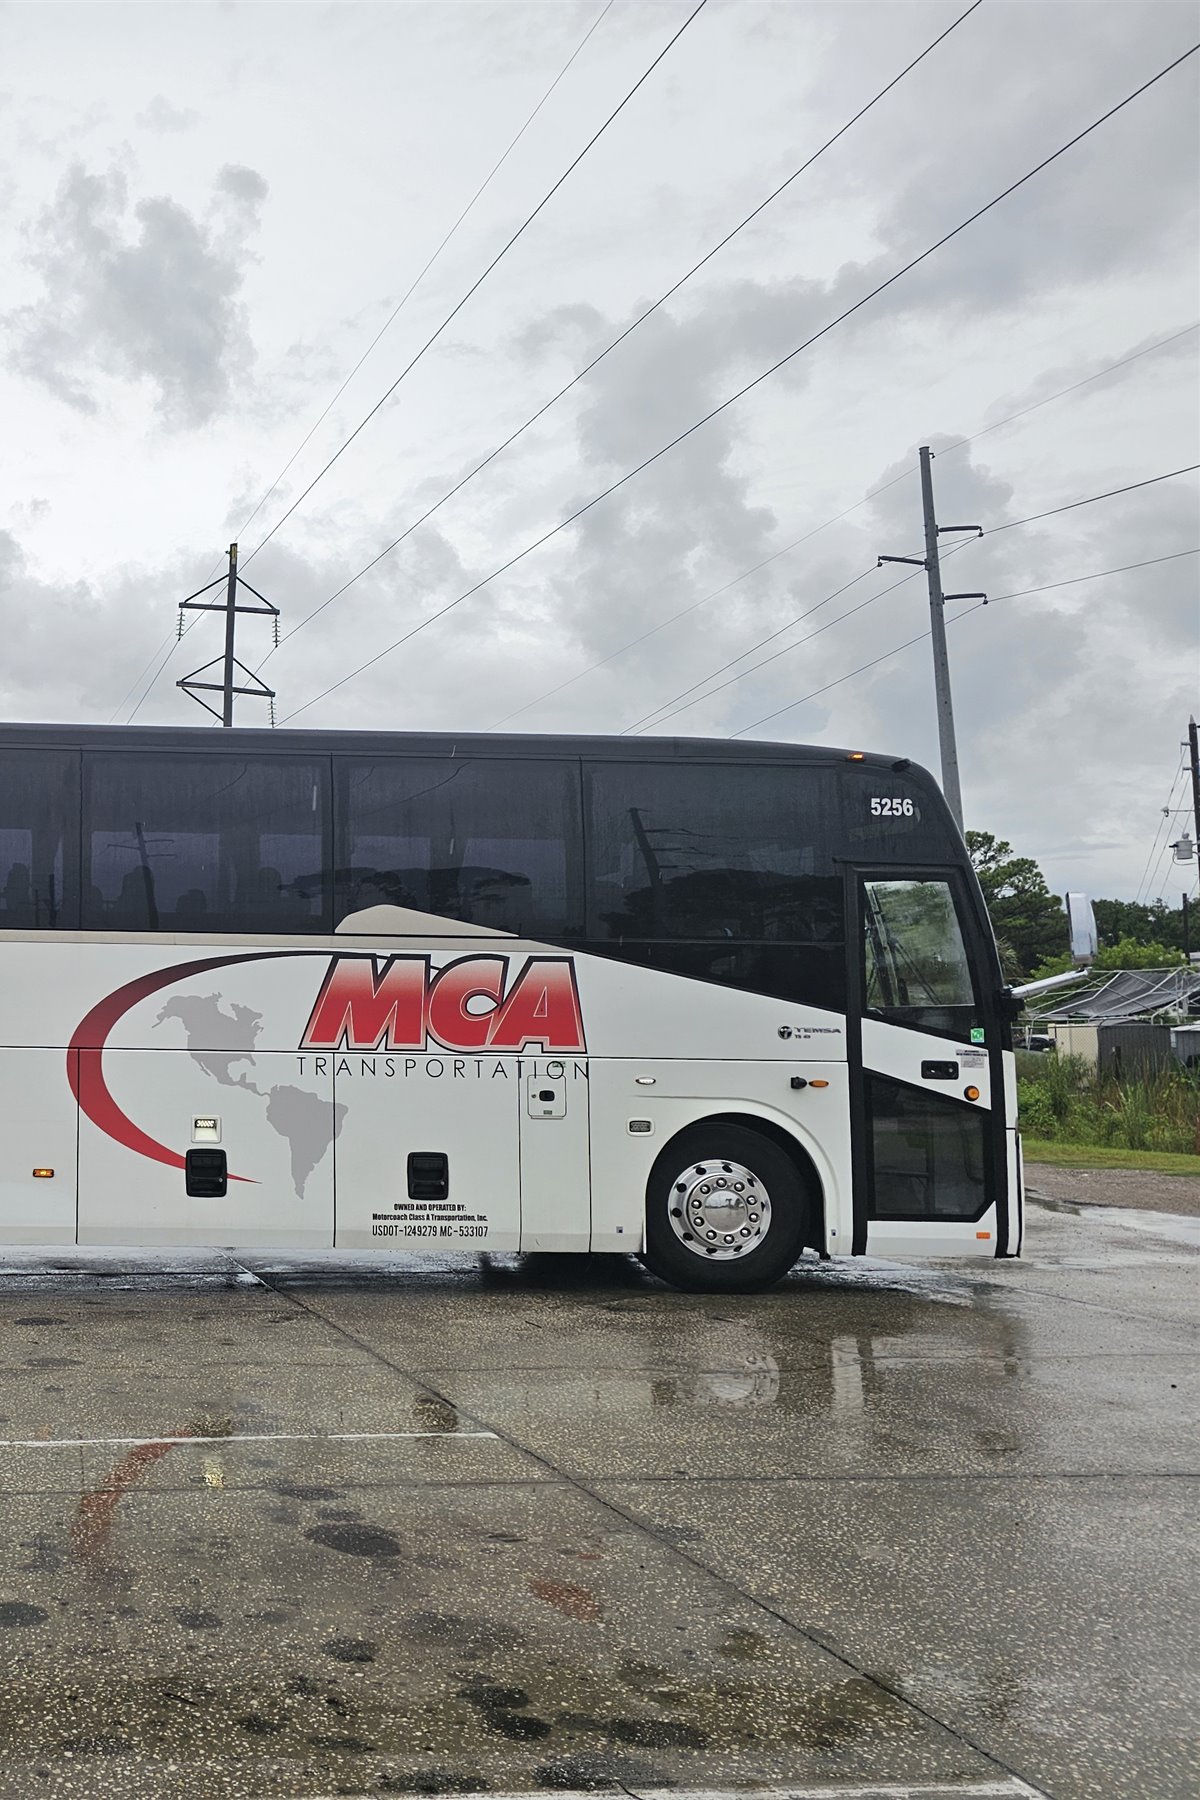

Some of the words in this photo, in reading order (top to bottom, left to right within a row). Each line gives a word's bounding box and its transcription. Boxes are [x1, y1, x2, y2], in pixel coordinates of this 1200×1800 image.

[870, 798, 914, 816] 5256
[298, 953, 588, 1054] MCA
[297, 1057, 589, 1080] TRANSPORTATION
[394, 1203, 415, 1211] OWNED
[416, 1203, 427, 1211] AND
[457, 1204, 467, 1212] BY:
[372, 1213, 408, 1221] Motorcoach
[408, 1213, 425, 1221] Class
[431, 1214, 477, 1222] Transportation,
[477, 1214, 488, 1222] Inc.
[372, 1225, 438, 1236] USDOT-1249279
[439, 1225, 489, 1237] MC-533107
